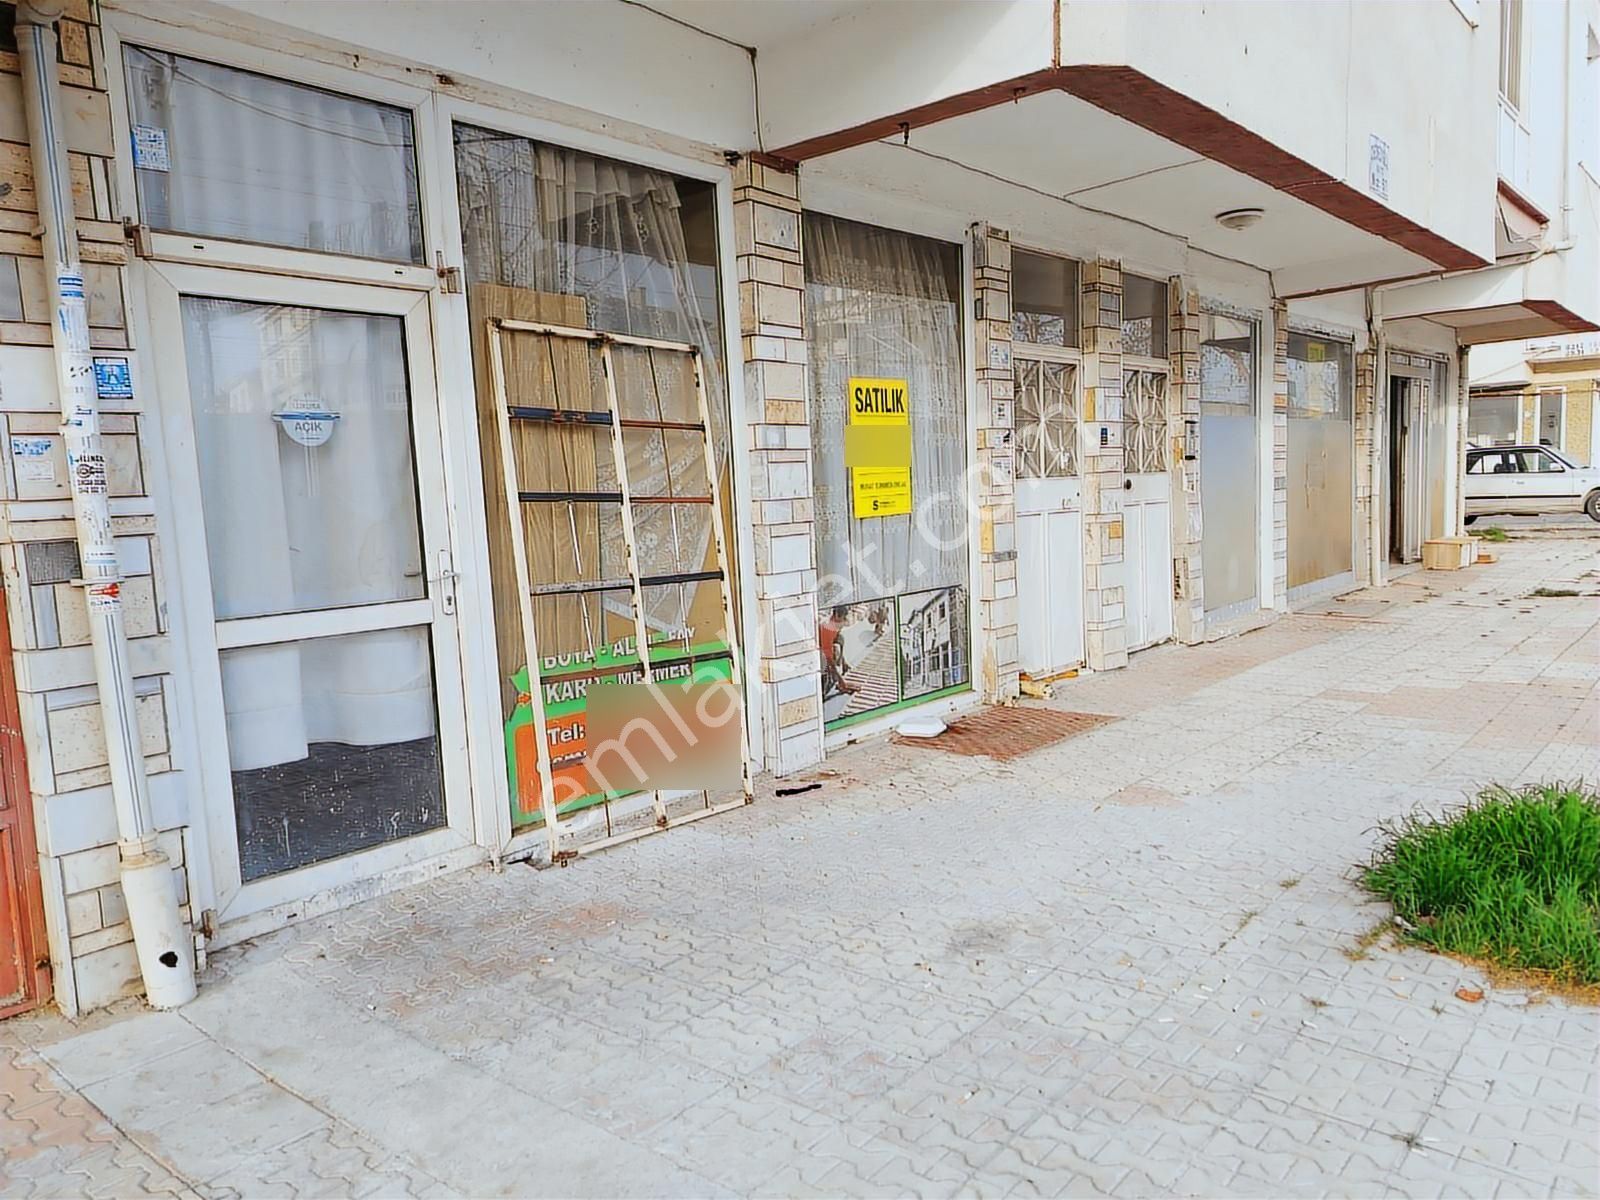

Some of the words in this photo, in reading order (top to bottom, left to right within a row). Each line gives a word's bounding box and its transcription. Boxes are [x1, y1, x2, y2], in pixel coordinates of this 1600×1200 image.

[855, 387, 904, 413] SATILIK
[295, 421, 322, 433] AÇIK
[548, 723, 586, 746] Tel:
